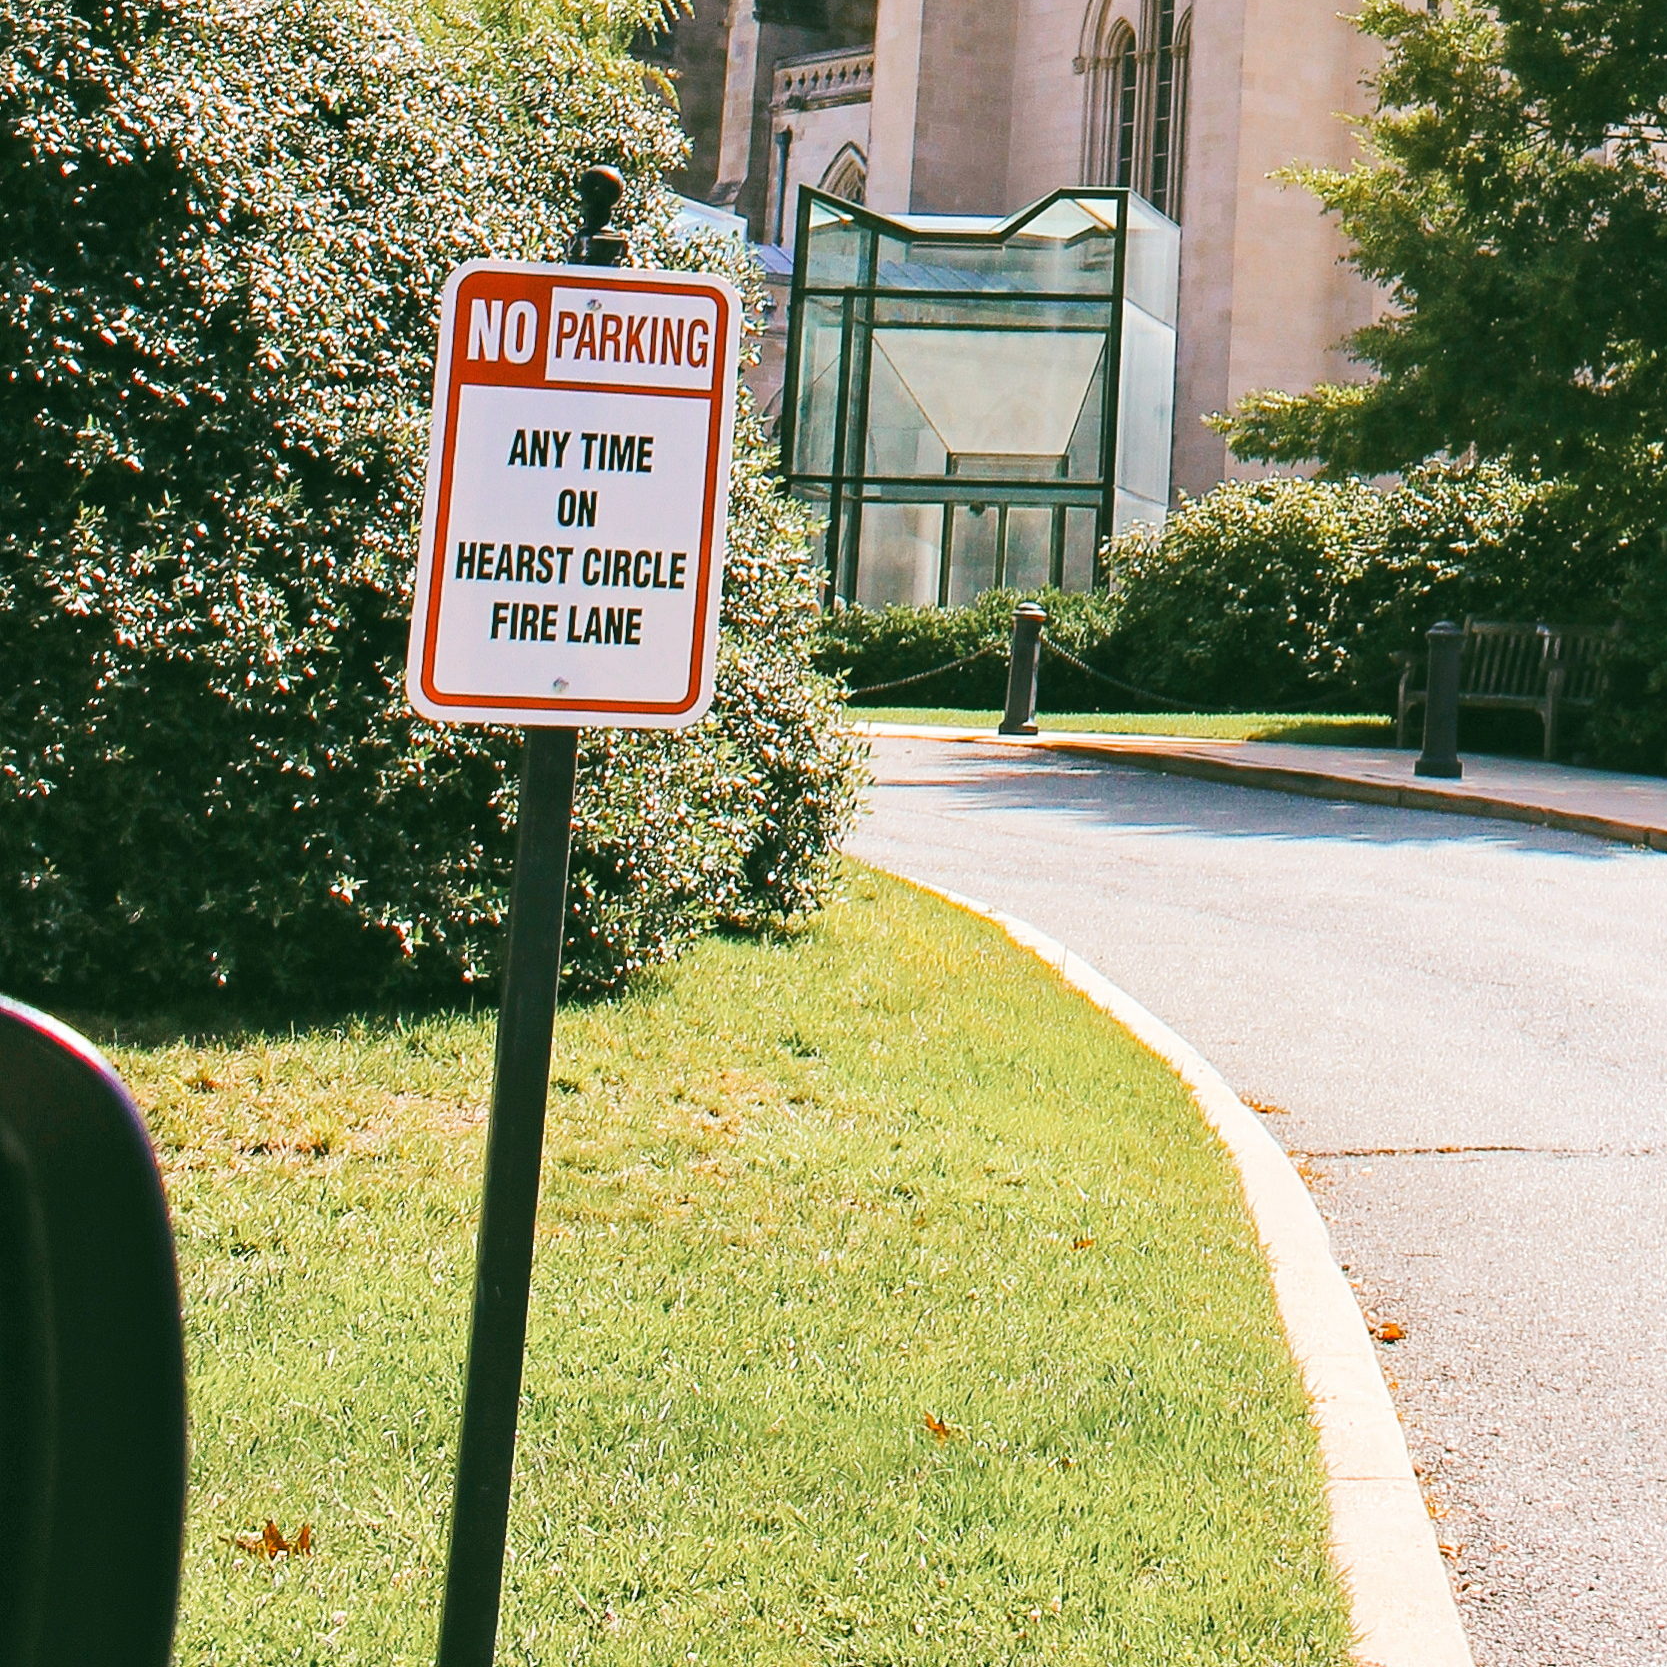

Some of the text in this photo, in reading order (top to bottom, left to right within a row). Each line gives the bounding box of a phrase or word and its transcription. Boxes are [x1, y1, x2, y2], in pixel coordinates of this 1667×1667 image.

[466, 298, 709, 368] NO PARKING
[507, 429, 654, 473] ANY TIME
[557, 488, 598, 527] ON
[455, 541, 687, 589] HEARST CIRCLE
[489, 602, 643, 645] FIRE LANE
